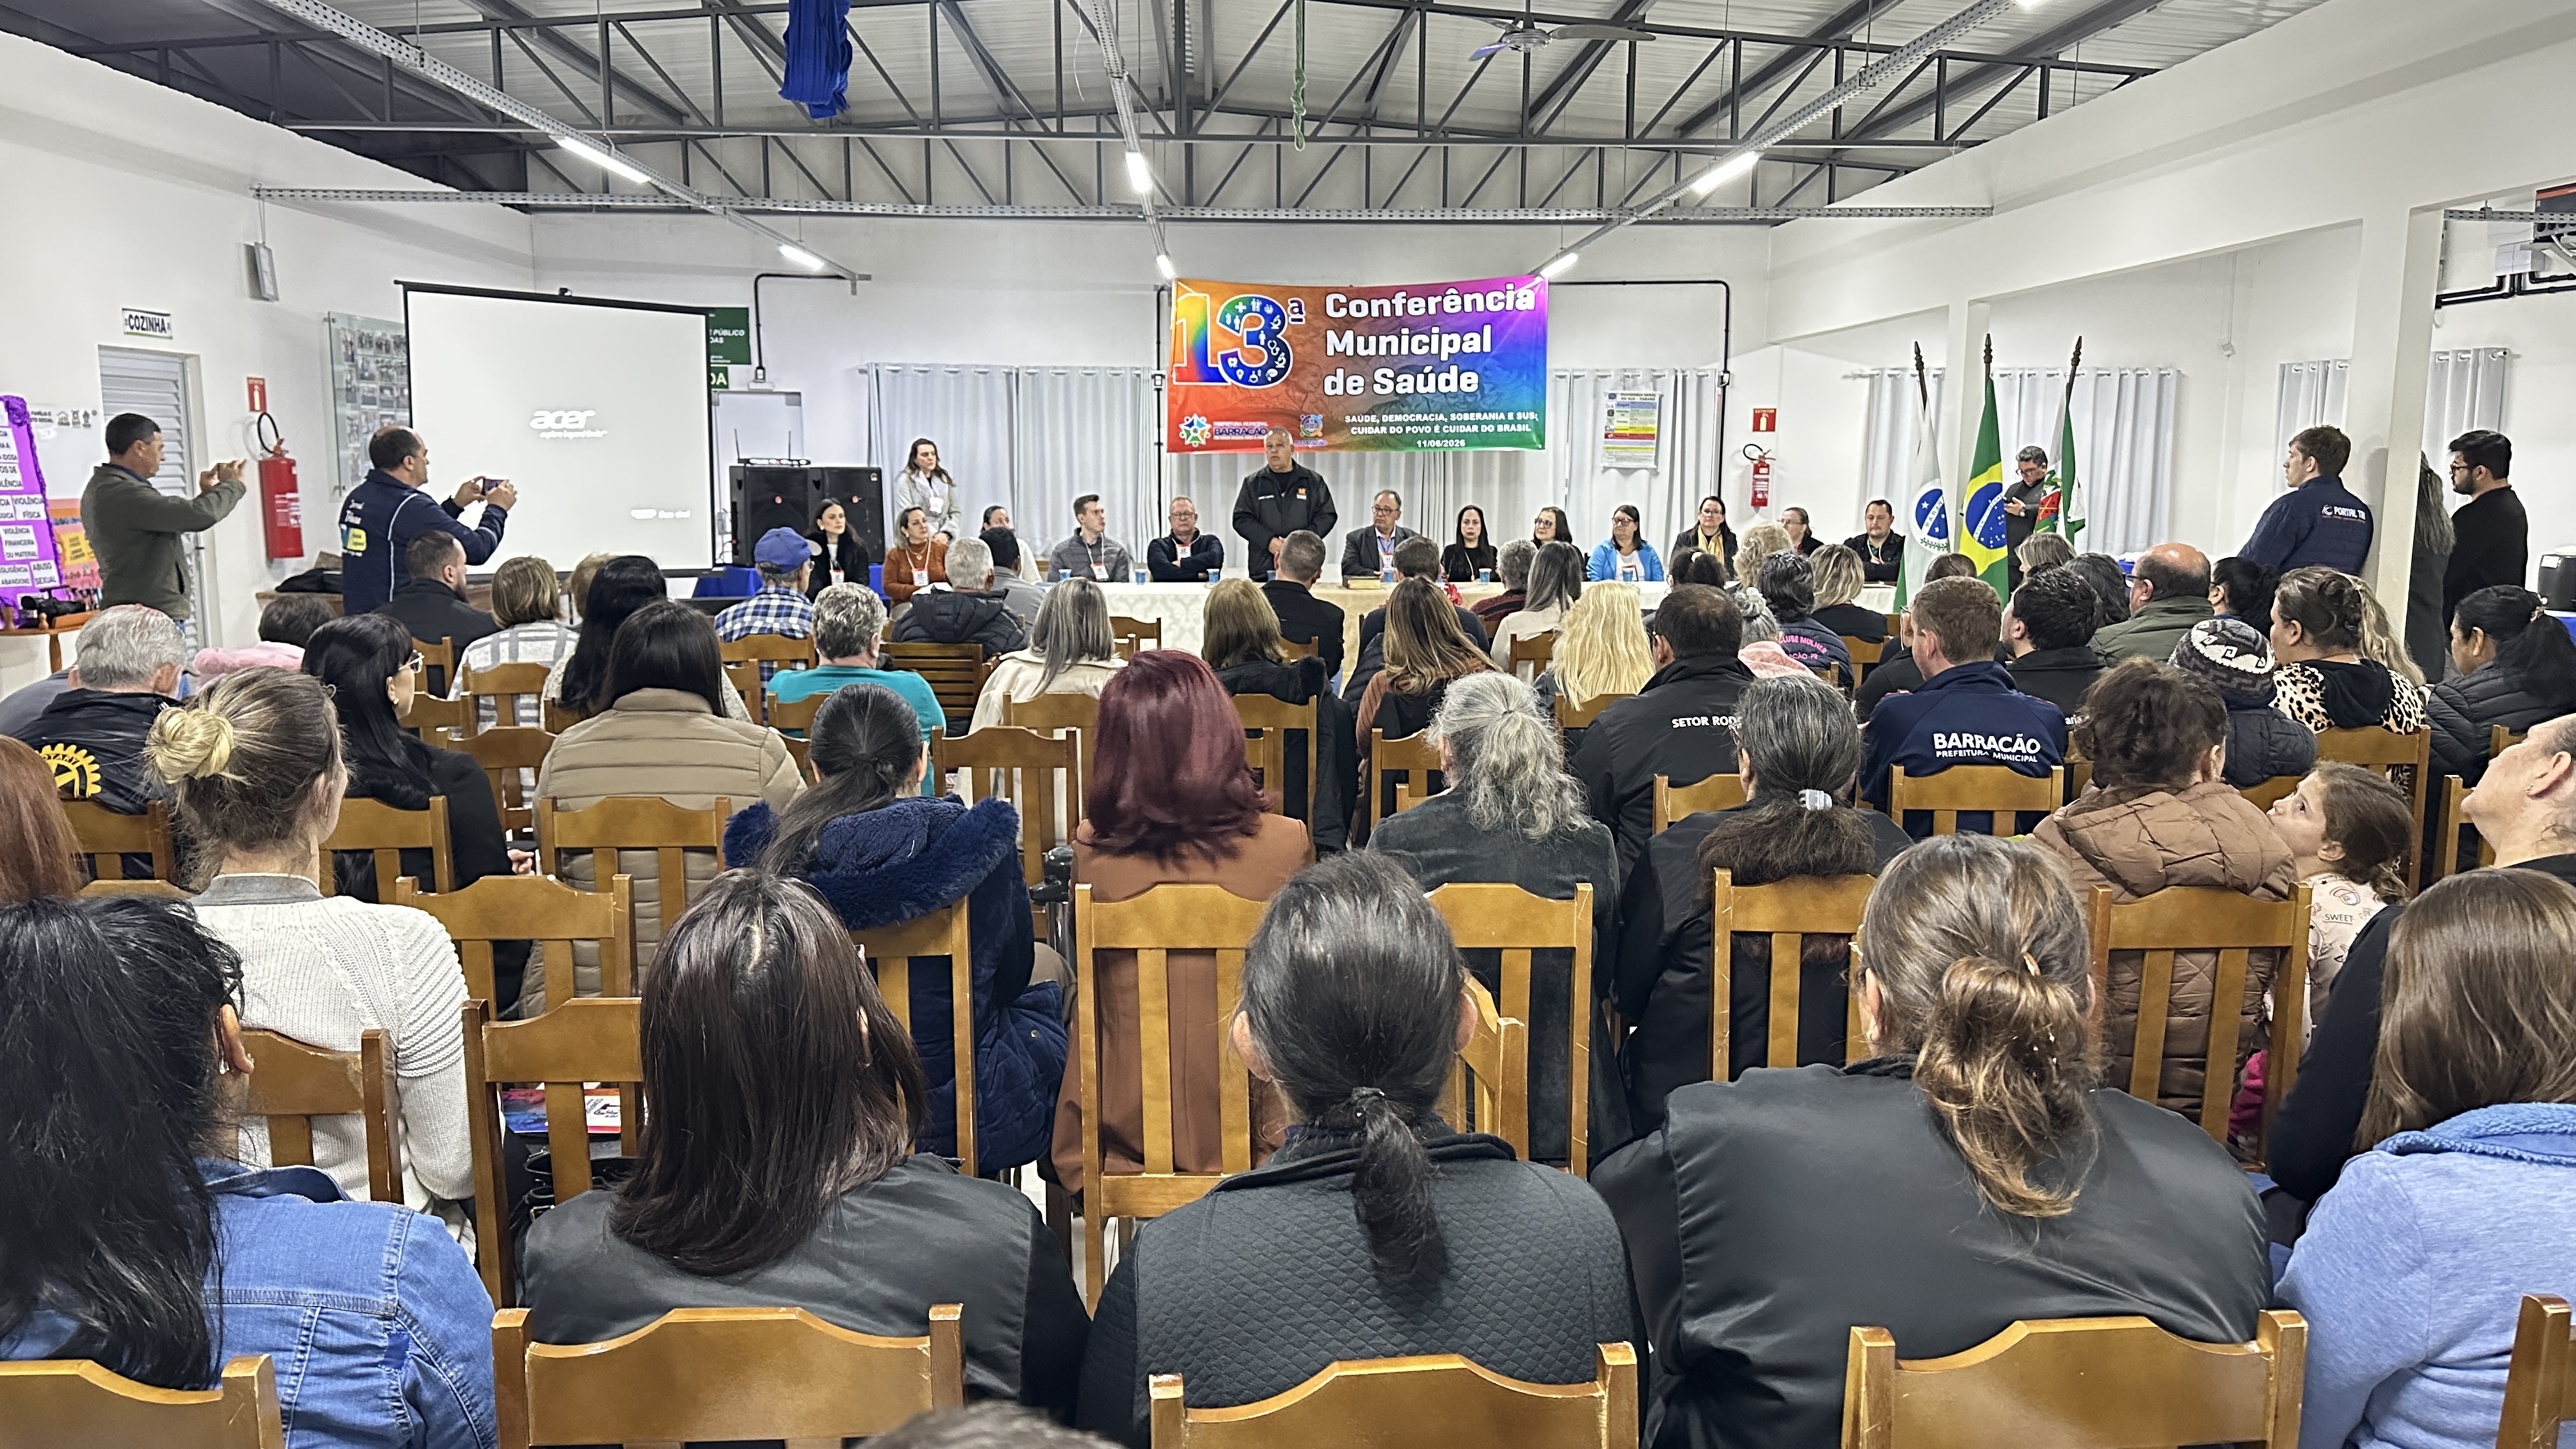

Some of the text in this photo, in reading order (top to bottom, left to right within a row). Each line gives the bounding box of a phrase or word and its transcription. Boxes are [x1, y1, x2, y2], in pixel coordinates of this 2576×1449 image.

[1325, 283, 1535, 318] Conferência
[128, 314, 167, 334] COZINHA
[1326, 324, 1492, 361] Municipal
[1323, 365, 1479, 395] de Saúde
[530, 410, 595, 429] acer
[1344, 414, 1380, 424] SAÚDE,
[1381, 413, 1448, 422] DEMOCRACIA,
[1450, 412, 1505, 421] SOBERANIA
[1351, 426, 1387, 434] CUIDAR
[1406, 425, 1432, 434] POVO
[1434, 424, 1440, 433] É
[2334, 506, 2358, 518] PORTAL
[1800, 636, 1827, 654] MULHER
[1671, 716, 1709, 728] SETOR
[1933, 732, 2041, 754] BARRACÃO
[1936, 749, 2038, 763] PREFEITURA MUNICIPAL
[2324, 914, 2354, 922] SWEET
